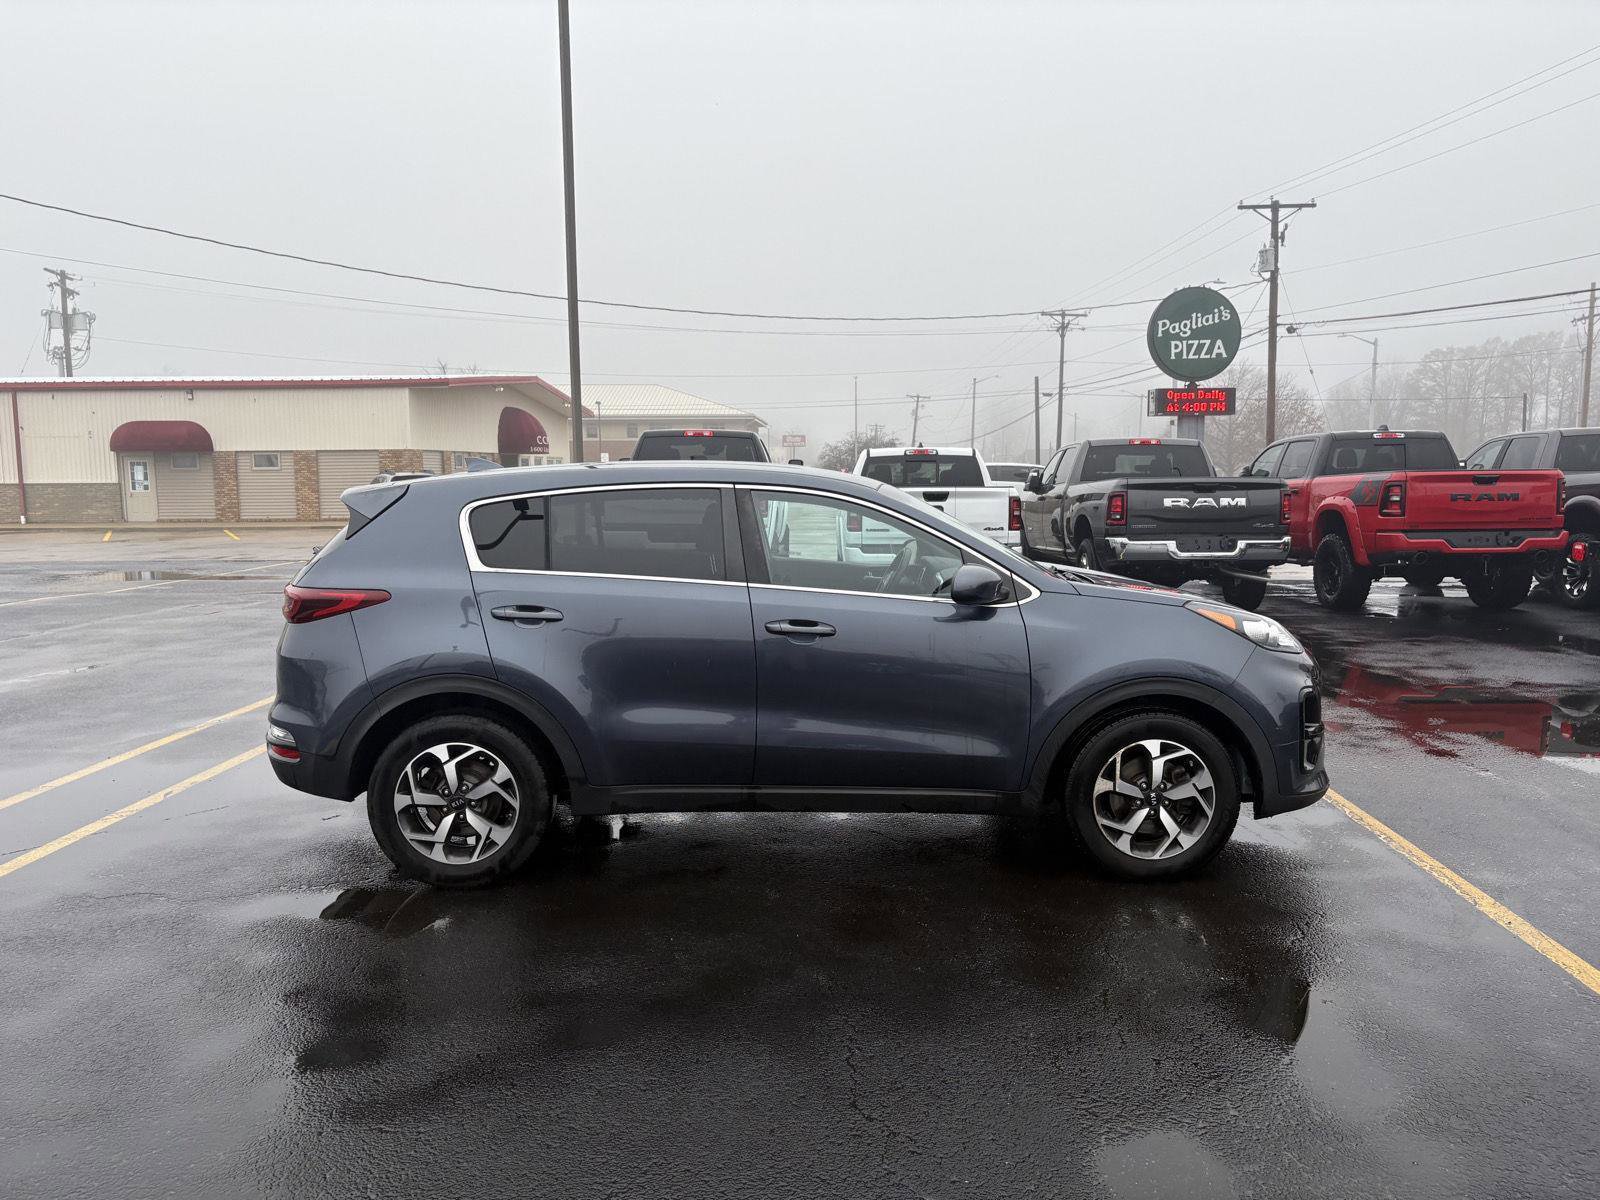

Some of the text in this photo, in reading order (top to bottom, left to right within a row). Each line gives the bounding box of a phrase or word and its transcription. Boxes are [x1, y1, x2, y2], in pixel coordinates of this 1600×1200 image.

[1157, 306, 1231, 337] Pagliai's
[1170, 339, 1227, 359] PIZZA
[1167, 390, 1226, 401] Open Daily
[1166, 402, 1226, 412] At 4:00 PM
[1450, 492, 1521, 502] RAM
[1163, 497, 1247, 509] RAM
[451, 799, 465, 808] KIA
